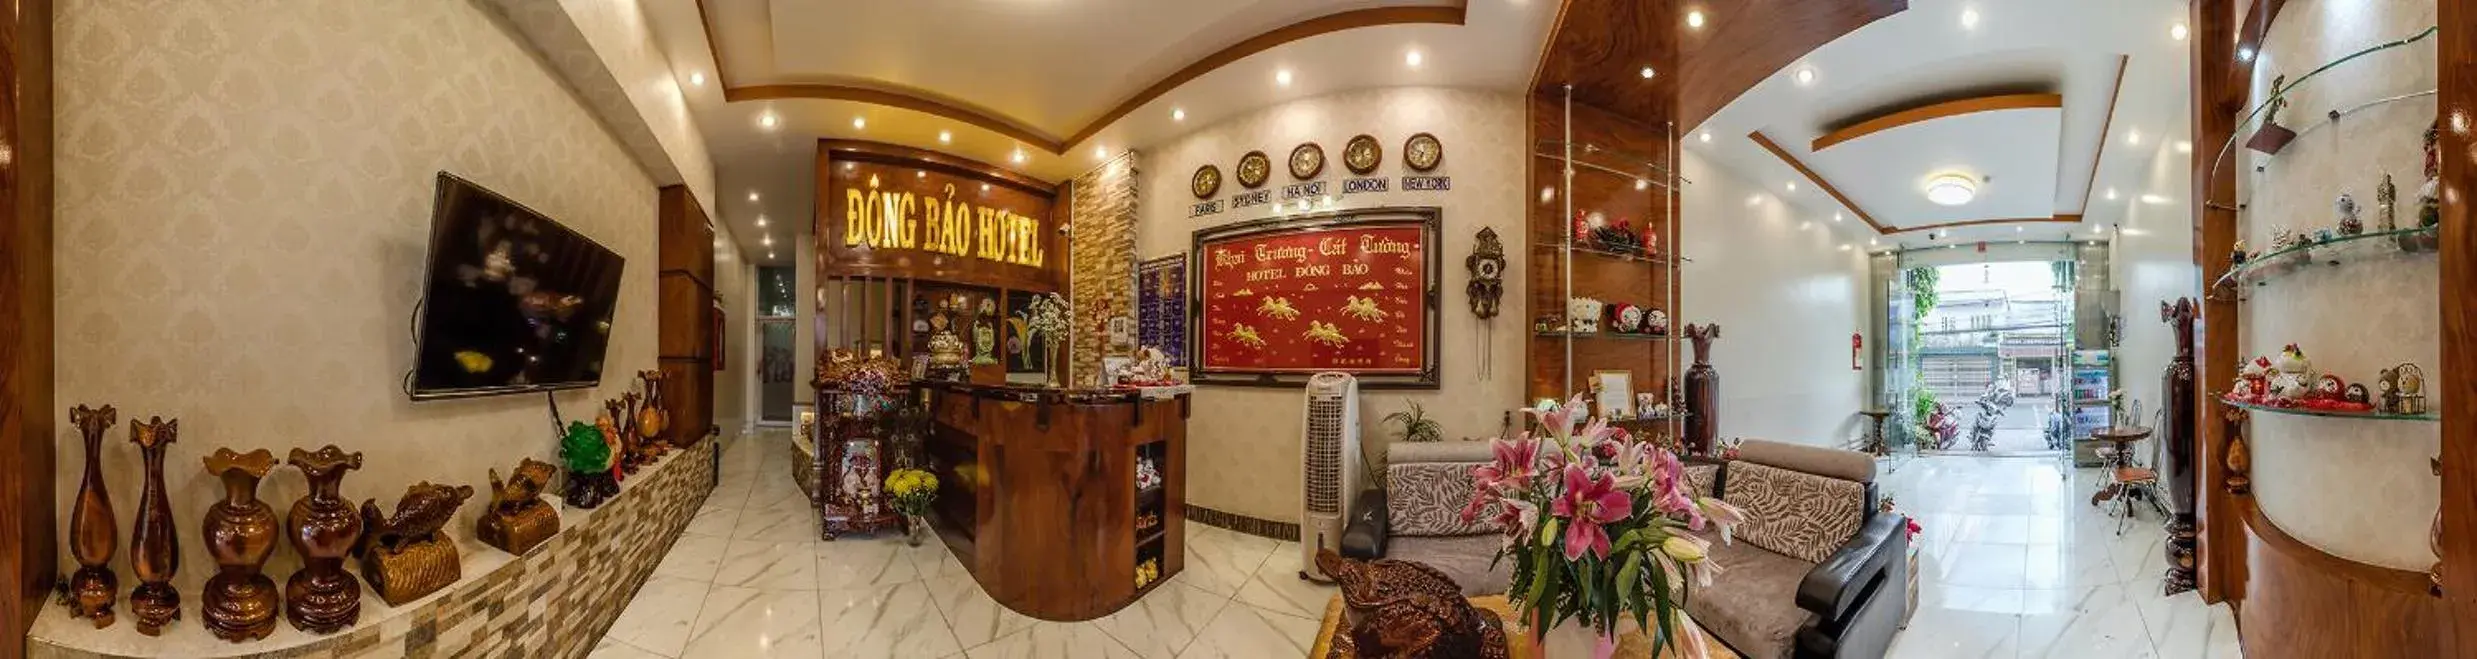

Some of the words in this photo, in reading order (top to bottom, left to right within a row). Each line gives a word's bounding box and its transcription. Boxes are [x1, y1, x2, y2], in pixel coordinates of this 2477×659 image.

[1232, 191, 1269, 208] SYDNEY
[846, 173, 917, 249] ĐÔNG
[923, 183, 970, 257] BẢO
[977, 206, 1044, 268] HOTEL
[1246, 268, 1287, 282] HOTEL
